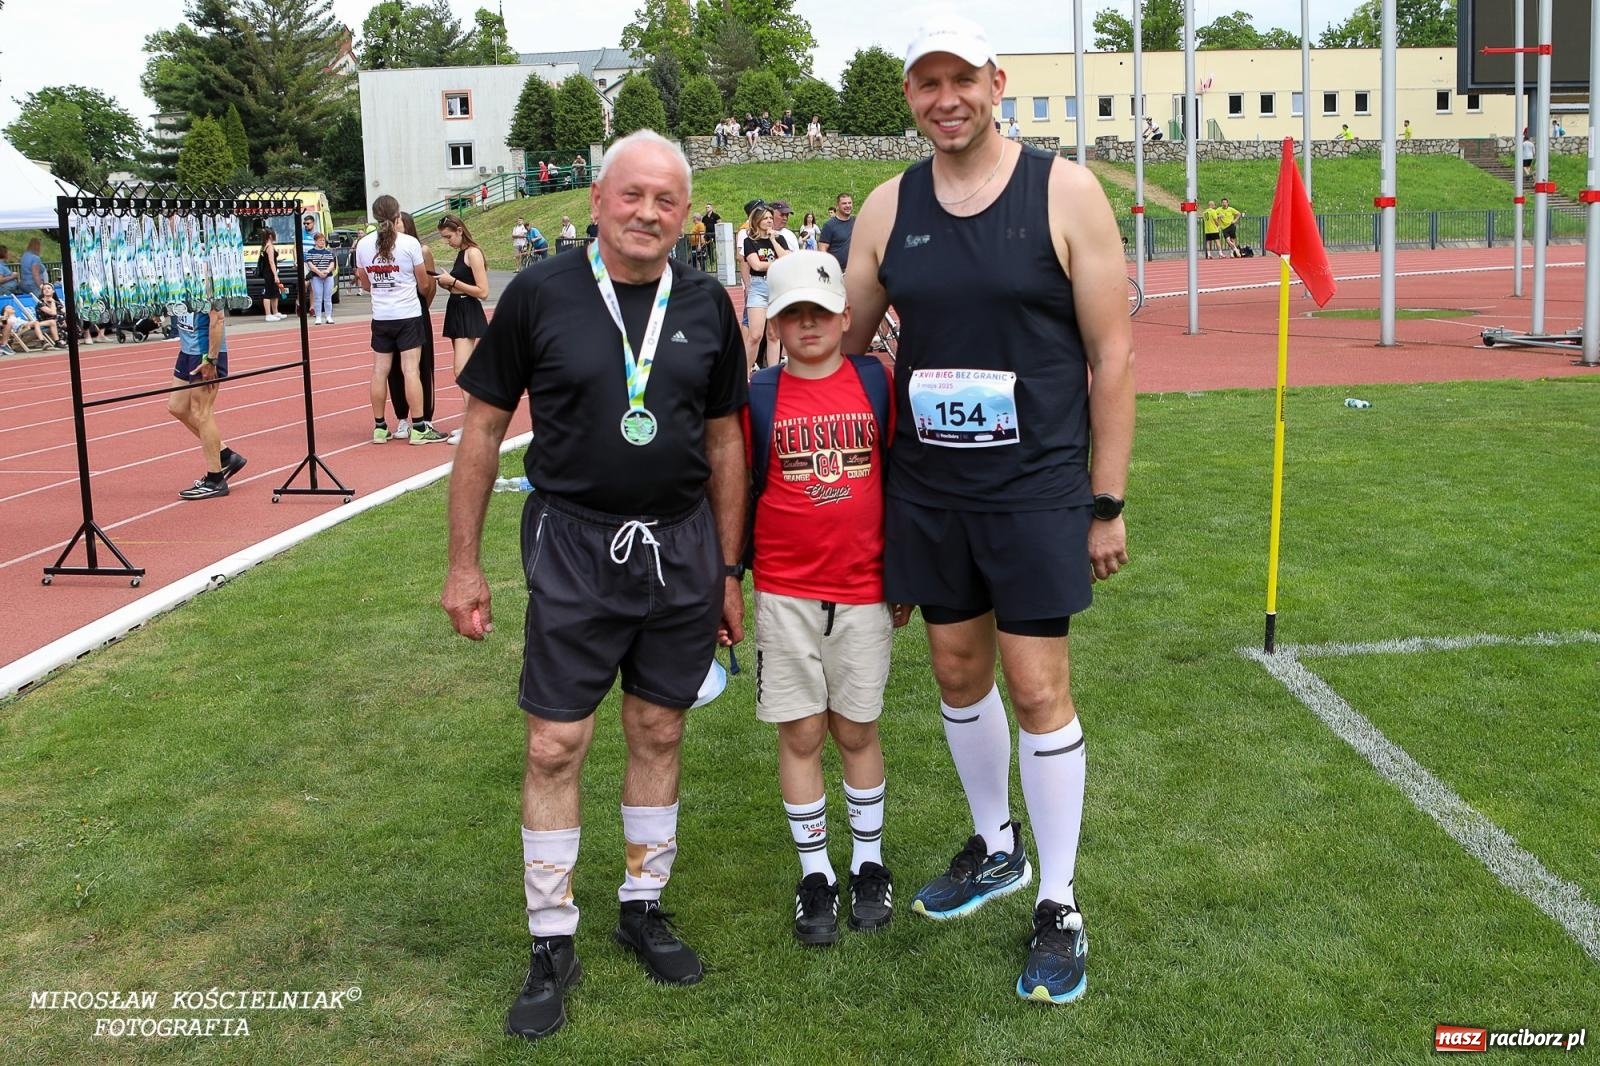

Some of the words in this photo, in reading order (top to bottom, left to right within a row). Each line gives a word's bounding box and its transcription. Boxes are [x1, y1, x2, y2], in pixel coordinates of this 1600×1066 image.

[935, 371, 954, 379] BIEG
[956, 371, 971, 379] BEZ
[973, 372, 1008, 381] GRANIC
[936, 401, 987, 427] 154
[774, 421, 875, 454] REDSKINS
[783, 474, 811, 482] ORANGE
[847, 469, 871, 479] COUNTY
[816, 452, 840, 477] 84
